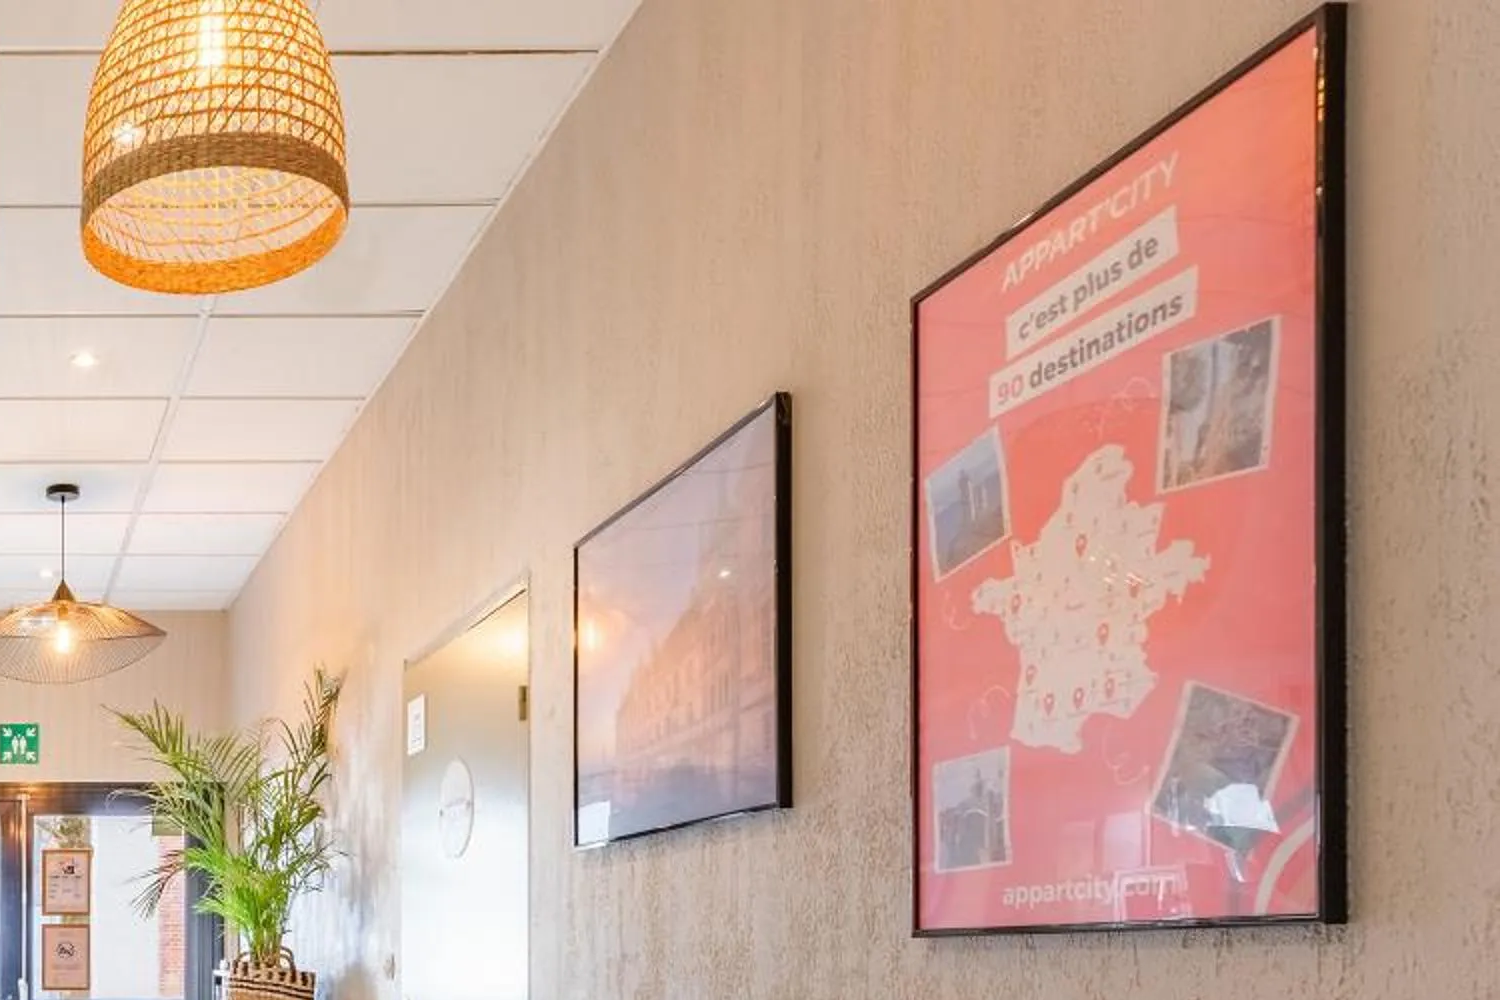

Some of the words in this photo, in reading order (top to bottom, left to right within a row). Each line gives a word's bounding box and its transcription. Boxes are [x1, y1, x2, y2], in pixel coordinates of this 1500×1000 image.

[1002, 150, 1179, 292] APPART'CITY
[1019, 297, 1068, 339] c'est
[1074, 262, 1123, 313] plus
[1129, 235, 1158, 269] de
[997, 373, 1025, 406] 90
[1029, 294, 1183, 388] destinations
